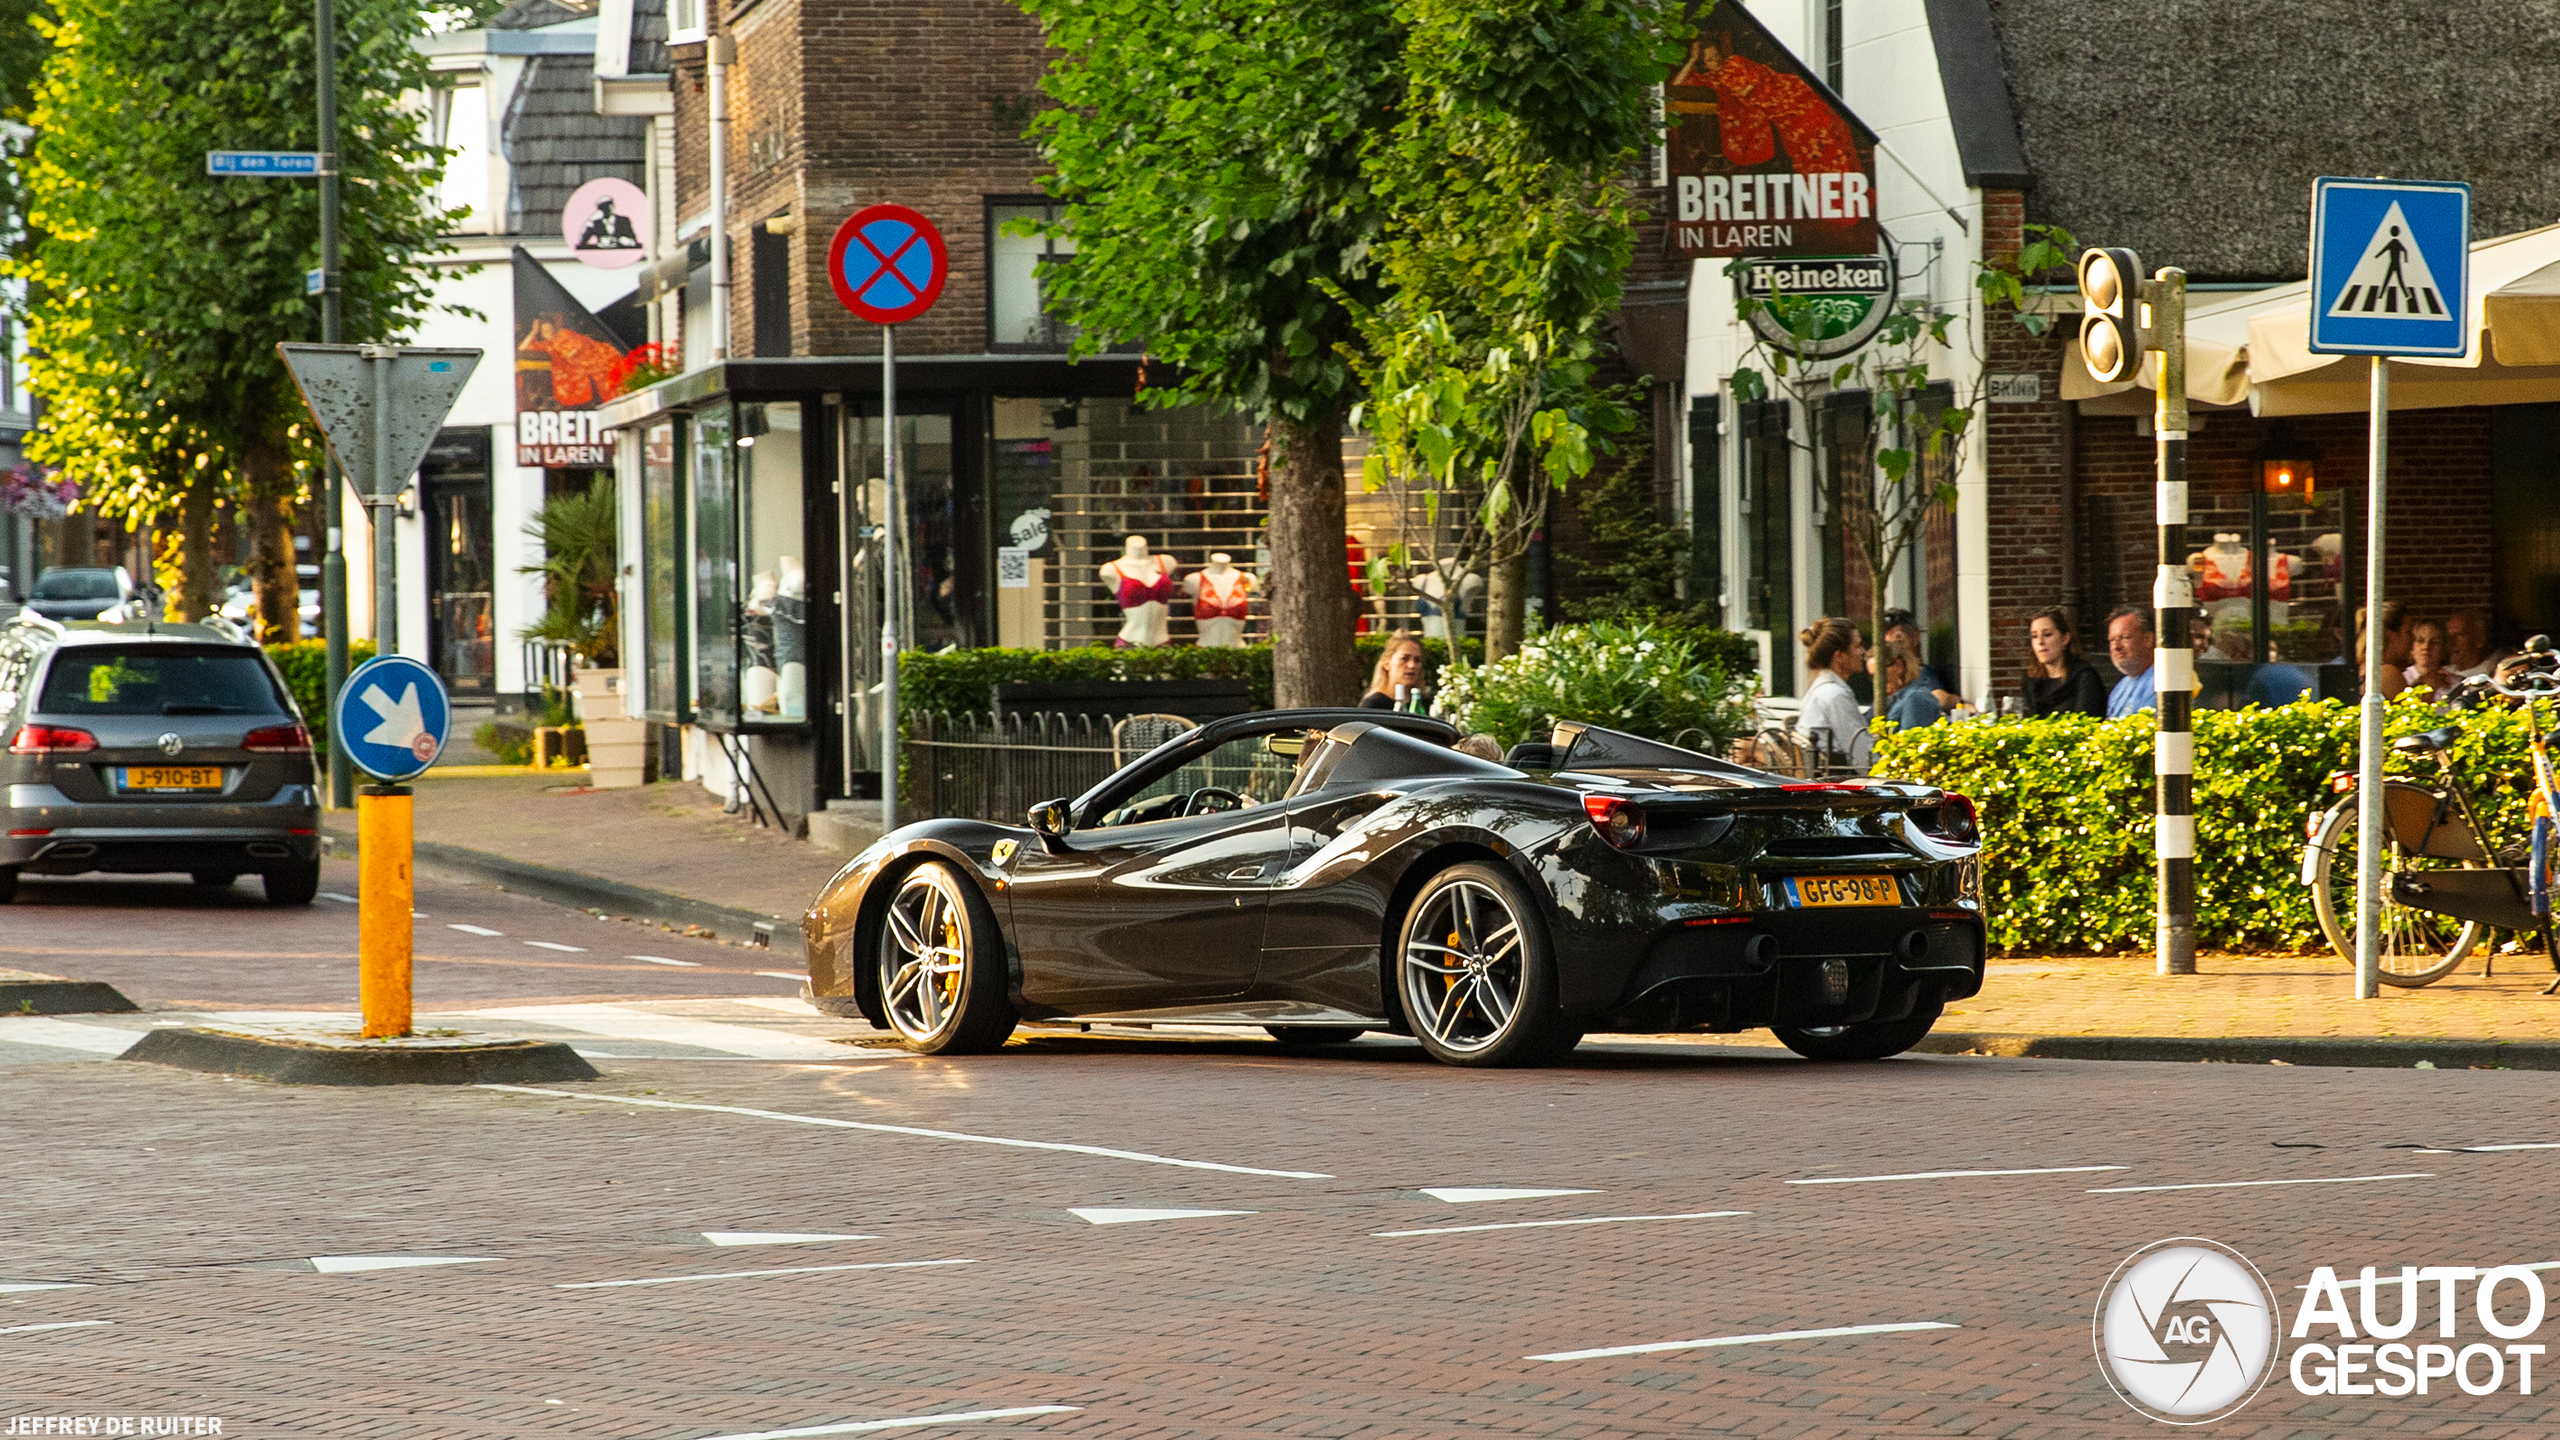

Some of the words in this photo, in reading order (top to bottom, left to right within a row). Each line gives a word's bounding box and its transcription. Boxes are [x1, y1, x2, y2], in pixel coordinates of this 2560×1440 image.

[240, 157, 268, 169] den
[272, 156, 313, 169] Toren
[1677, 172, 1870, 222] BREITNER
[1678, 226, 1705, 248] IN
[1712, 224, 1793, 248] LAREN
[1750, 263, 1885, 290] Heineken
[520, 447, 540, 464] IN
[544, 446, 605, 464] LAREN
[1011, 522, 1049, 546] sale
[136, 768, 213, 786] J-910-BT
[1803, 878, 1891, 903] GFG-98-P
